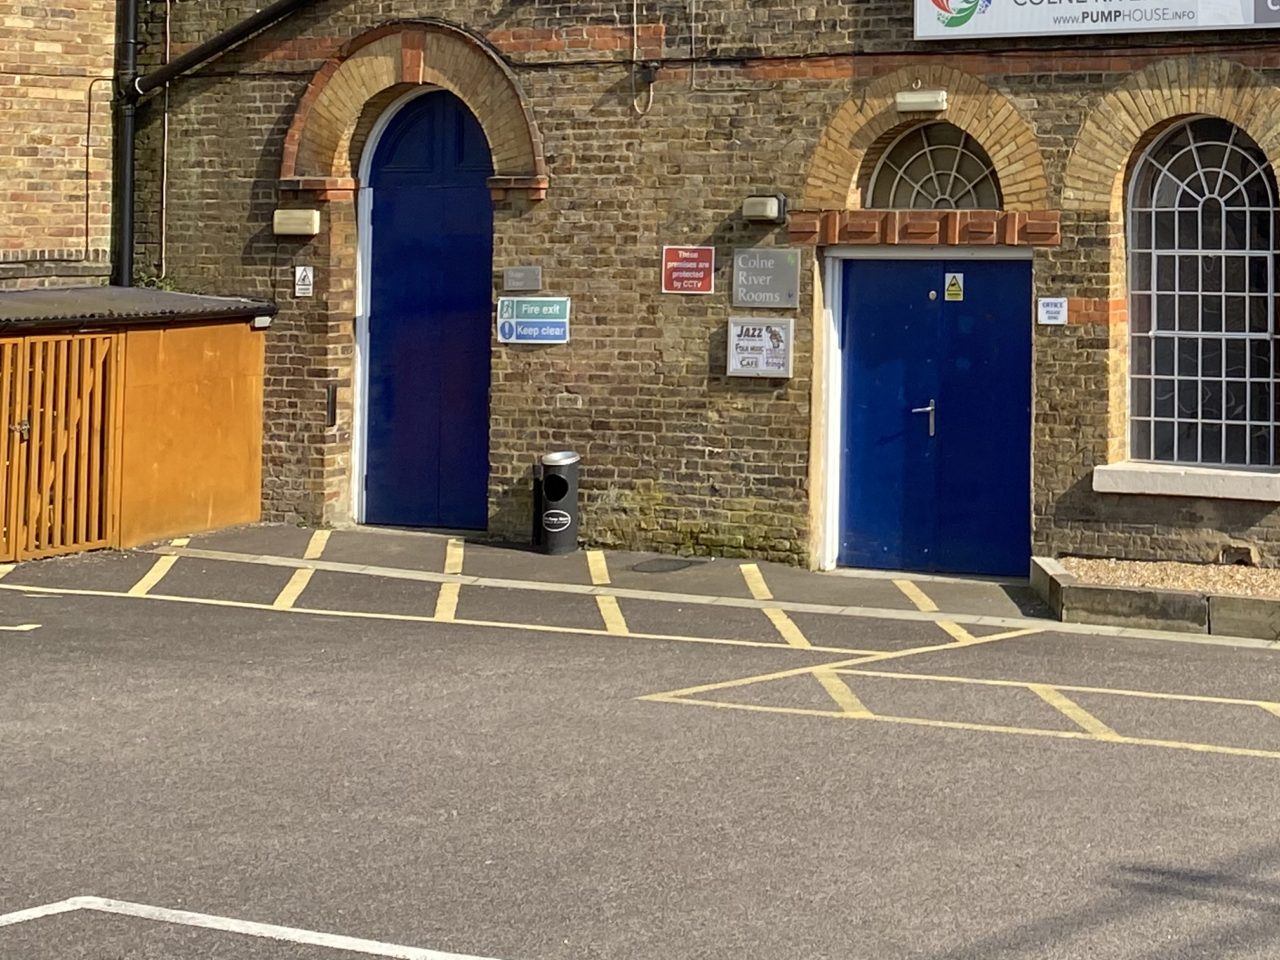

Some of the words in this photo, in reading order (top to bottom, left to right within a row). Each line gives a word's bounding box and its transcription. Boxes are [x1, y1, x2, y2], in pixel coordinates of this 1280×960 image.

[738, 254, 775, 269] Colne
[672, 271, 704, 279] protected
[738, 271, 772, 285] River
[673, 280, 682, 289] by
[682, 280, 702, 288] CCTV
[738, 287, 780, 302] Rooms
[522, 304, 540, 314] Fire
[542, 304, 560, 314] exit
[517, 325, 539, 338] Keep
[541, 326, 565, 336] clear
